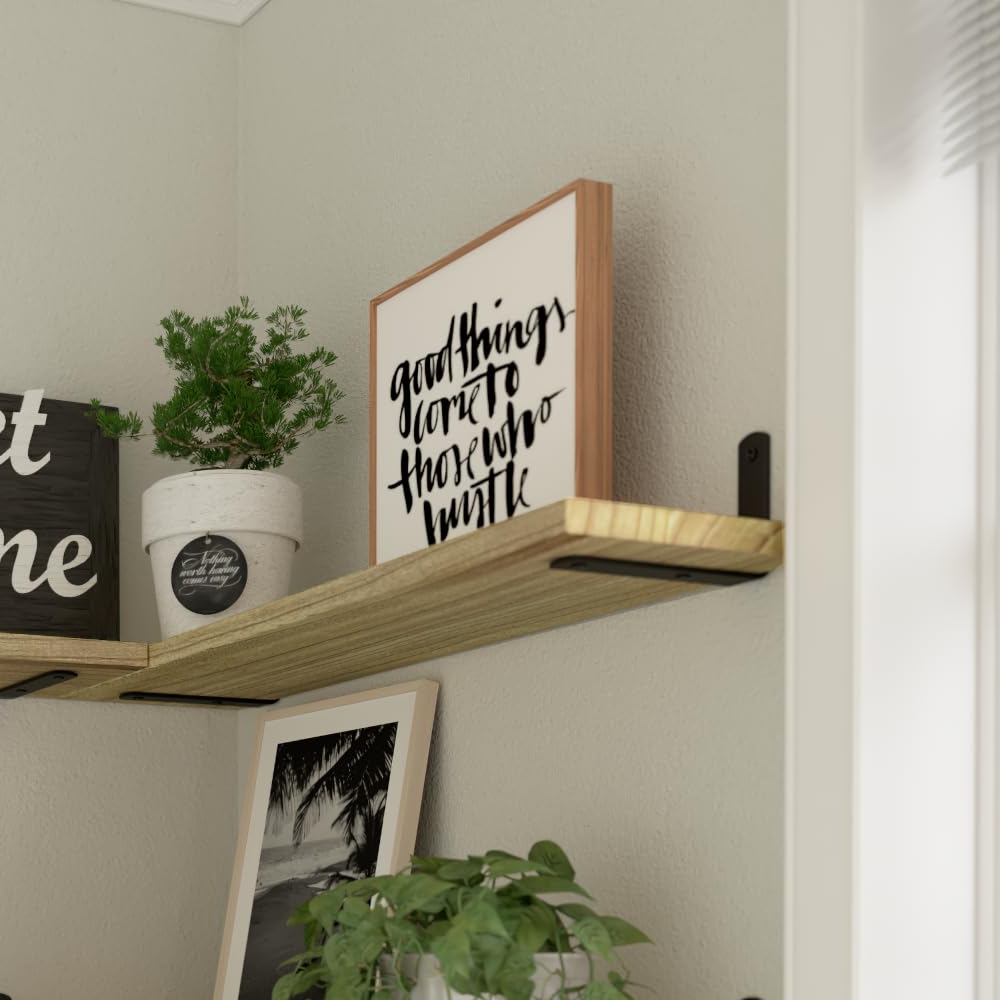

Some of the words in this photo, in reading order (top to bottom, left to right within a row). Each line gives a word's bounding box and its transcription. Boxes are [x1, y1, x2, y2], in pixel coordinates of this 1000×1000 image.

[390, 315, 455, 439] good
[454, 297, 575, 378] things
[413, 384, 479, 445] come
[461, 361, 520, 418] to
[388, 437, 479, 514] those
[482, 388, 566, 467] who
[424, 461, 531, 546] hustle
